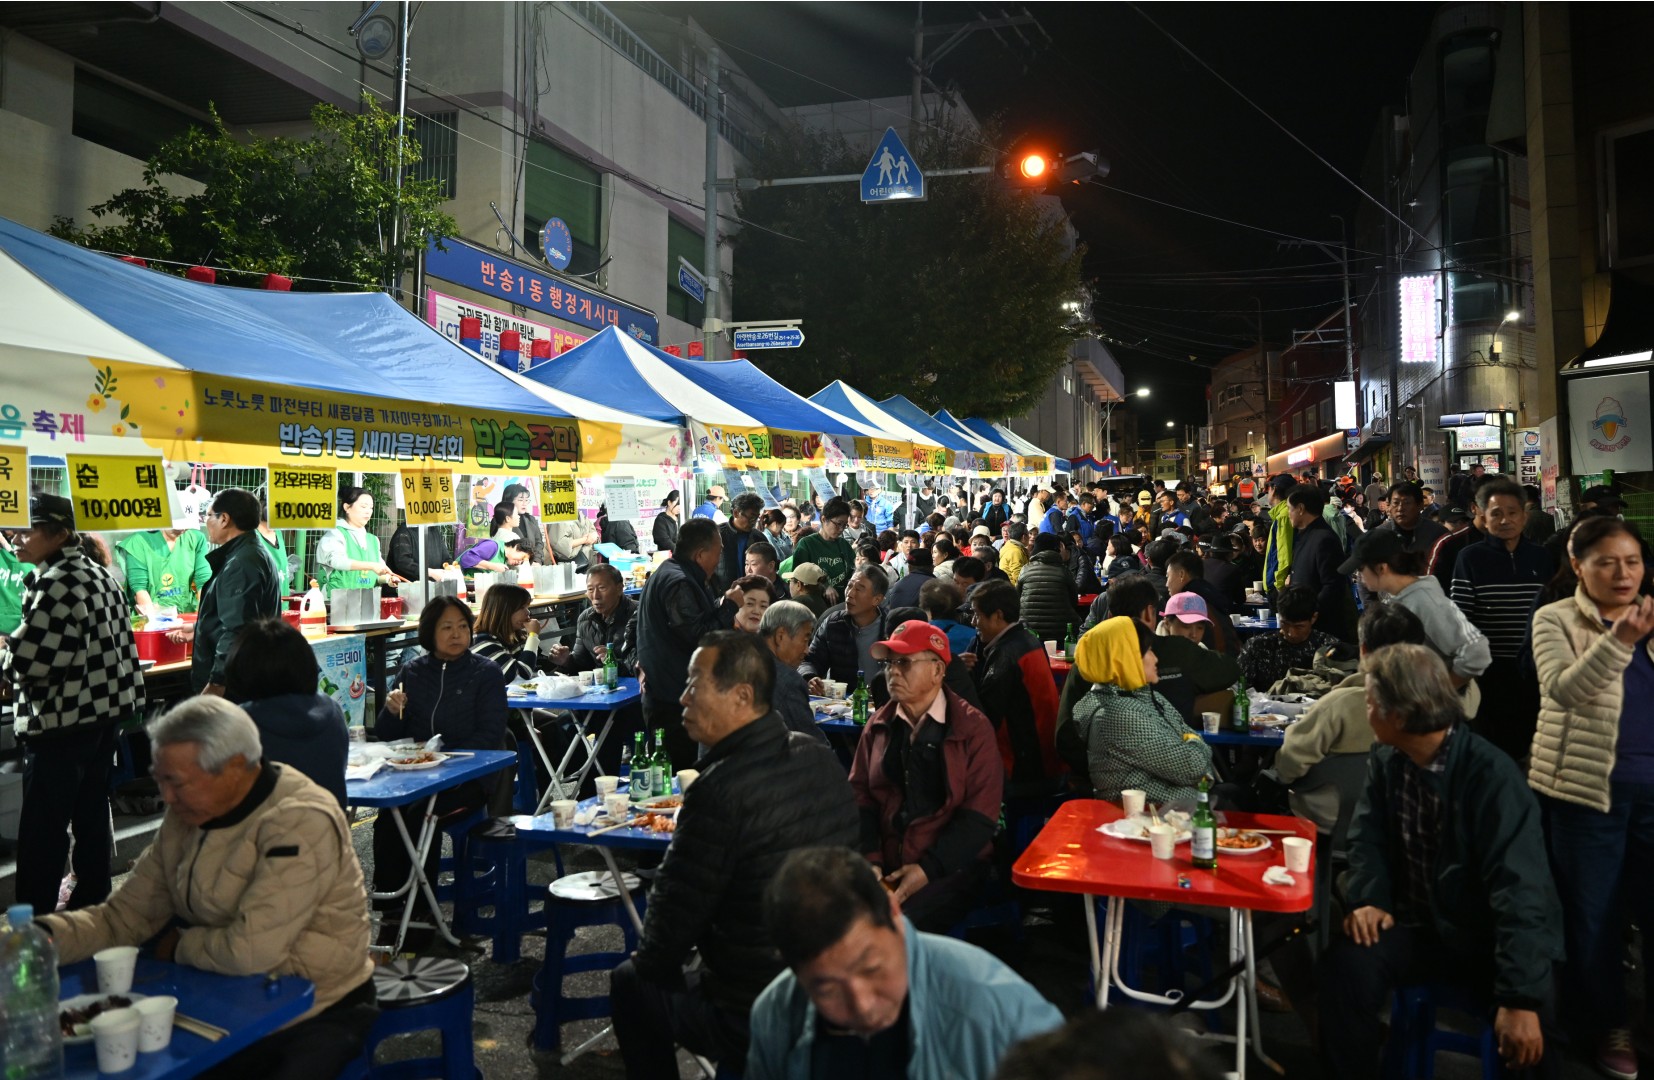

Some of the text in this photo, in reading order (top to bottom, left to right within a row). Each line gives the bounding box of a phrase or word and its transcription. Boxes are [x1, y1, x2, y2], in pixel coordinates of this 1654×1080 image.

[481, 260, 620, 327] 반송1동 행정게시대
[269, 396, 323, 417] 파전부터
[327, 403, 375, 423] 새콤달콤
[32, 409, 85, 442] 축제
[279, 422, 464, 463] 반송1동 새마을부녀회
[470, 417, 579, 472] 반송주막
[274, 470, 333, 491] 가오리무침
[80, 496, 162, 519] 10,000원
[274, 502, 333, 520] 10,000원
[408, 499, 452, 515] 10,000원
[544, 501, 575, 516] 10,000원
